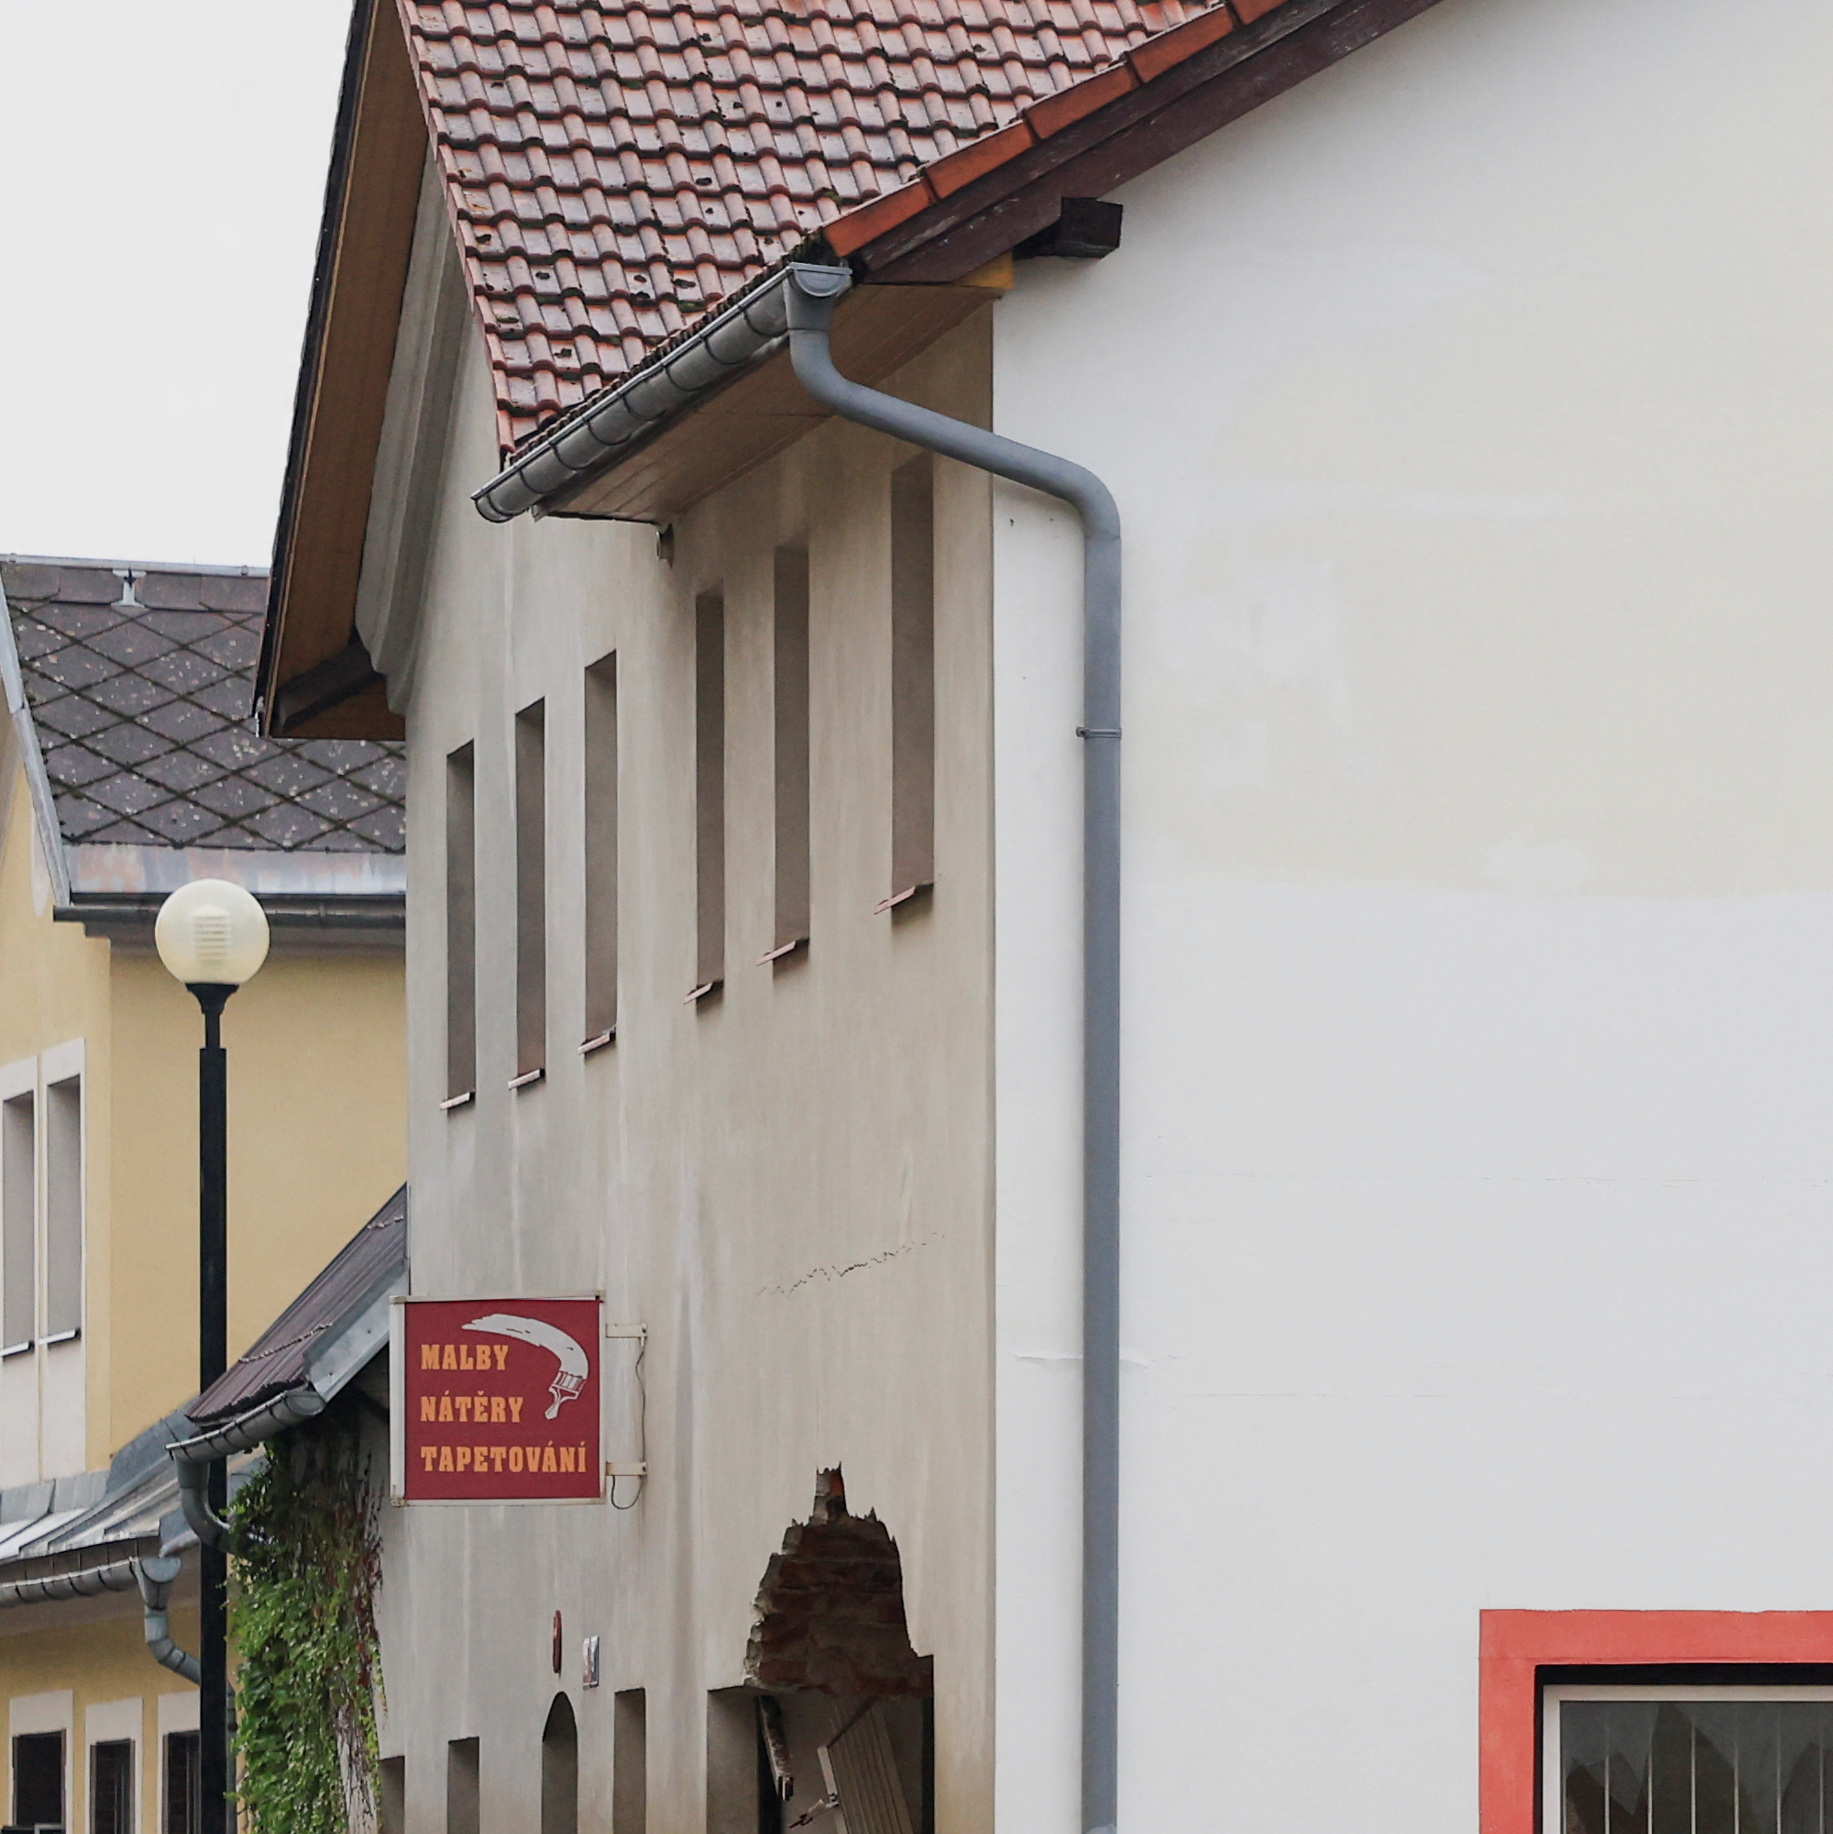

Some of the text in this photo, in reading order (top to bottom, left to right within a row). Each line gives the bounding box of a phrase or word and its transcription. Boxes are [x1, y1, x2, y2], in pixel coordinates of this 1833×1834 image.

[420, 1344, 509, 1371] MALBY
[420, 1390, 524, 1423] NÁTĚRY
[420, 1441, 587, 1473] TAPETOVÁNÍ
